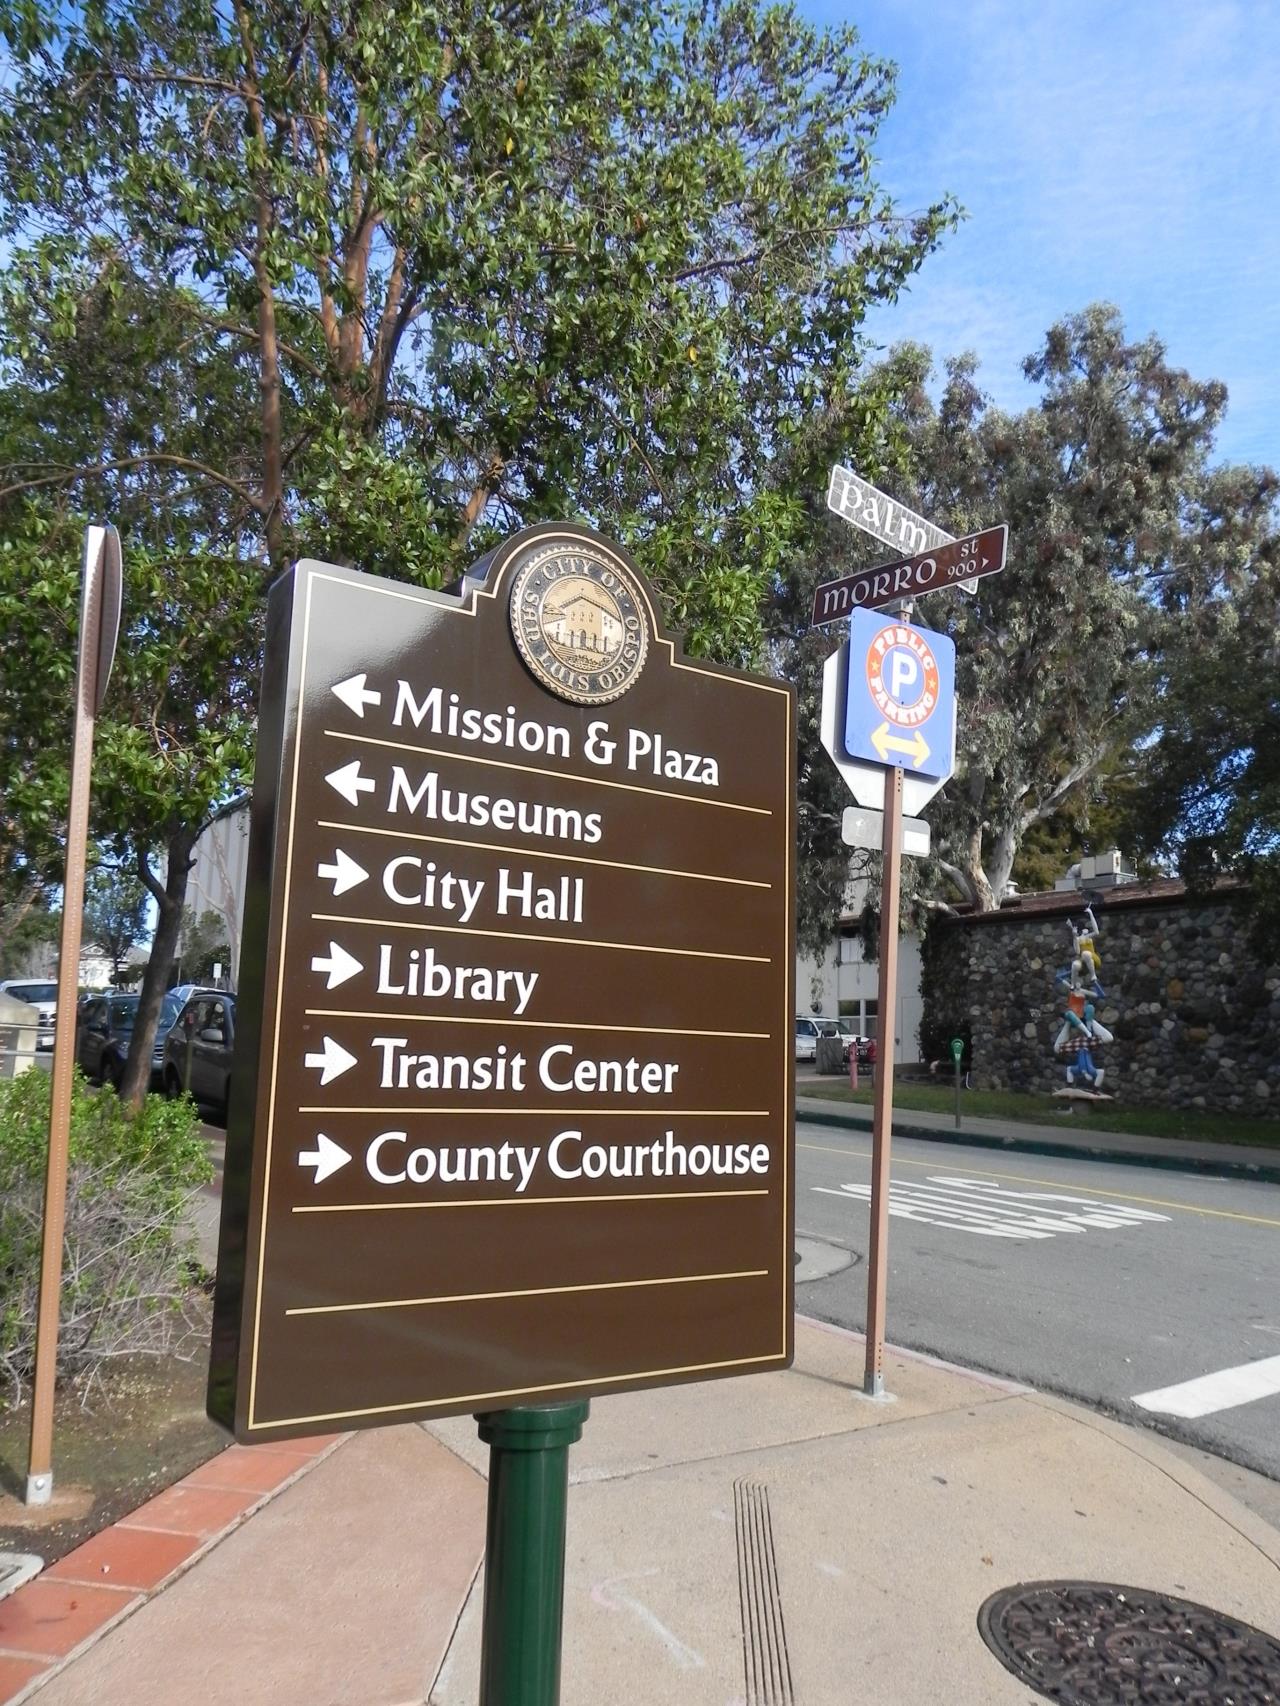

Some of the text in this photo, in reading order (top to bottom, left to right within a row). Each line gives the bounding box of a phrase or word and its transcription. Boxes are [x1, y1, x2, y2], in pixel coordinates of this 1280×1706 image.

[542, 557, 626, 598] CITY OF
[947, 559, 978, 580] 900
[523, 590, 640, 692] SAN LUIS OBISPO
[873, 627, 936, 672] PUBLIC
[869, 675, 936, 726] PARKING
[891, 651, 918, 698] P
[391, 679, 720, 786] Mission & Plaza
[387, 765, 603, 844] Museums
[382, 855, 584, 923] City Hall
[376, 944, 539, 1015] Library
[372, 1037, 680, 1094] Transit Center
[365, 1130, 770, 1192] County Courthouse
